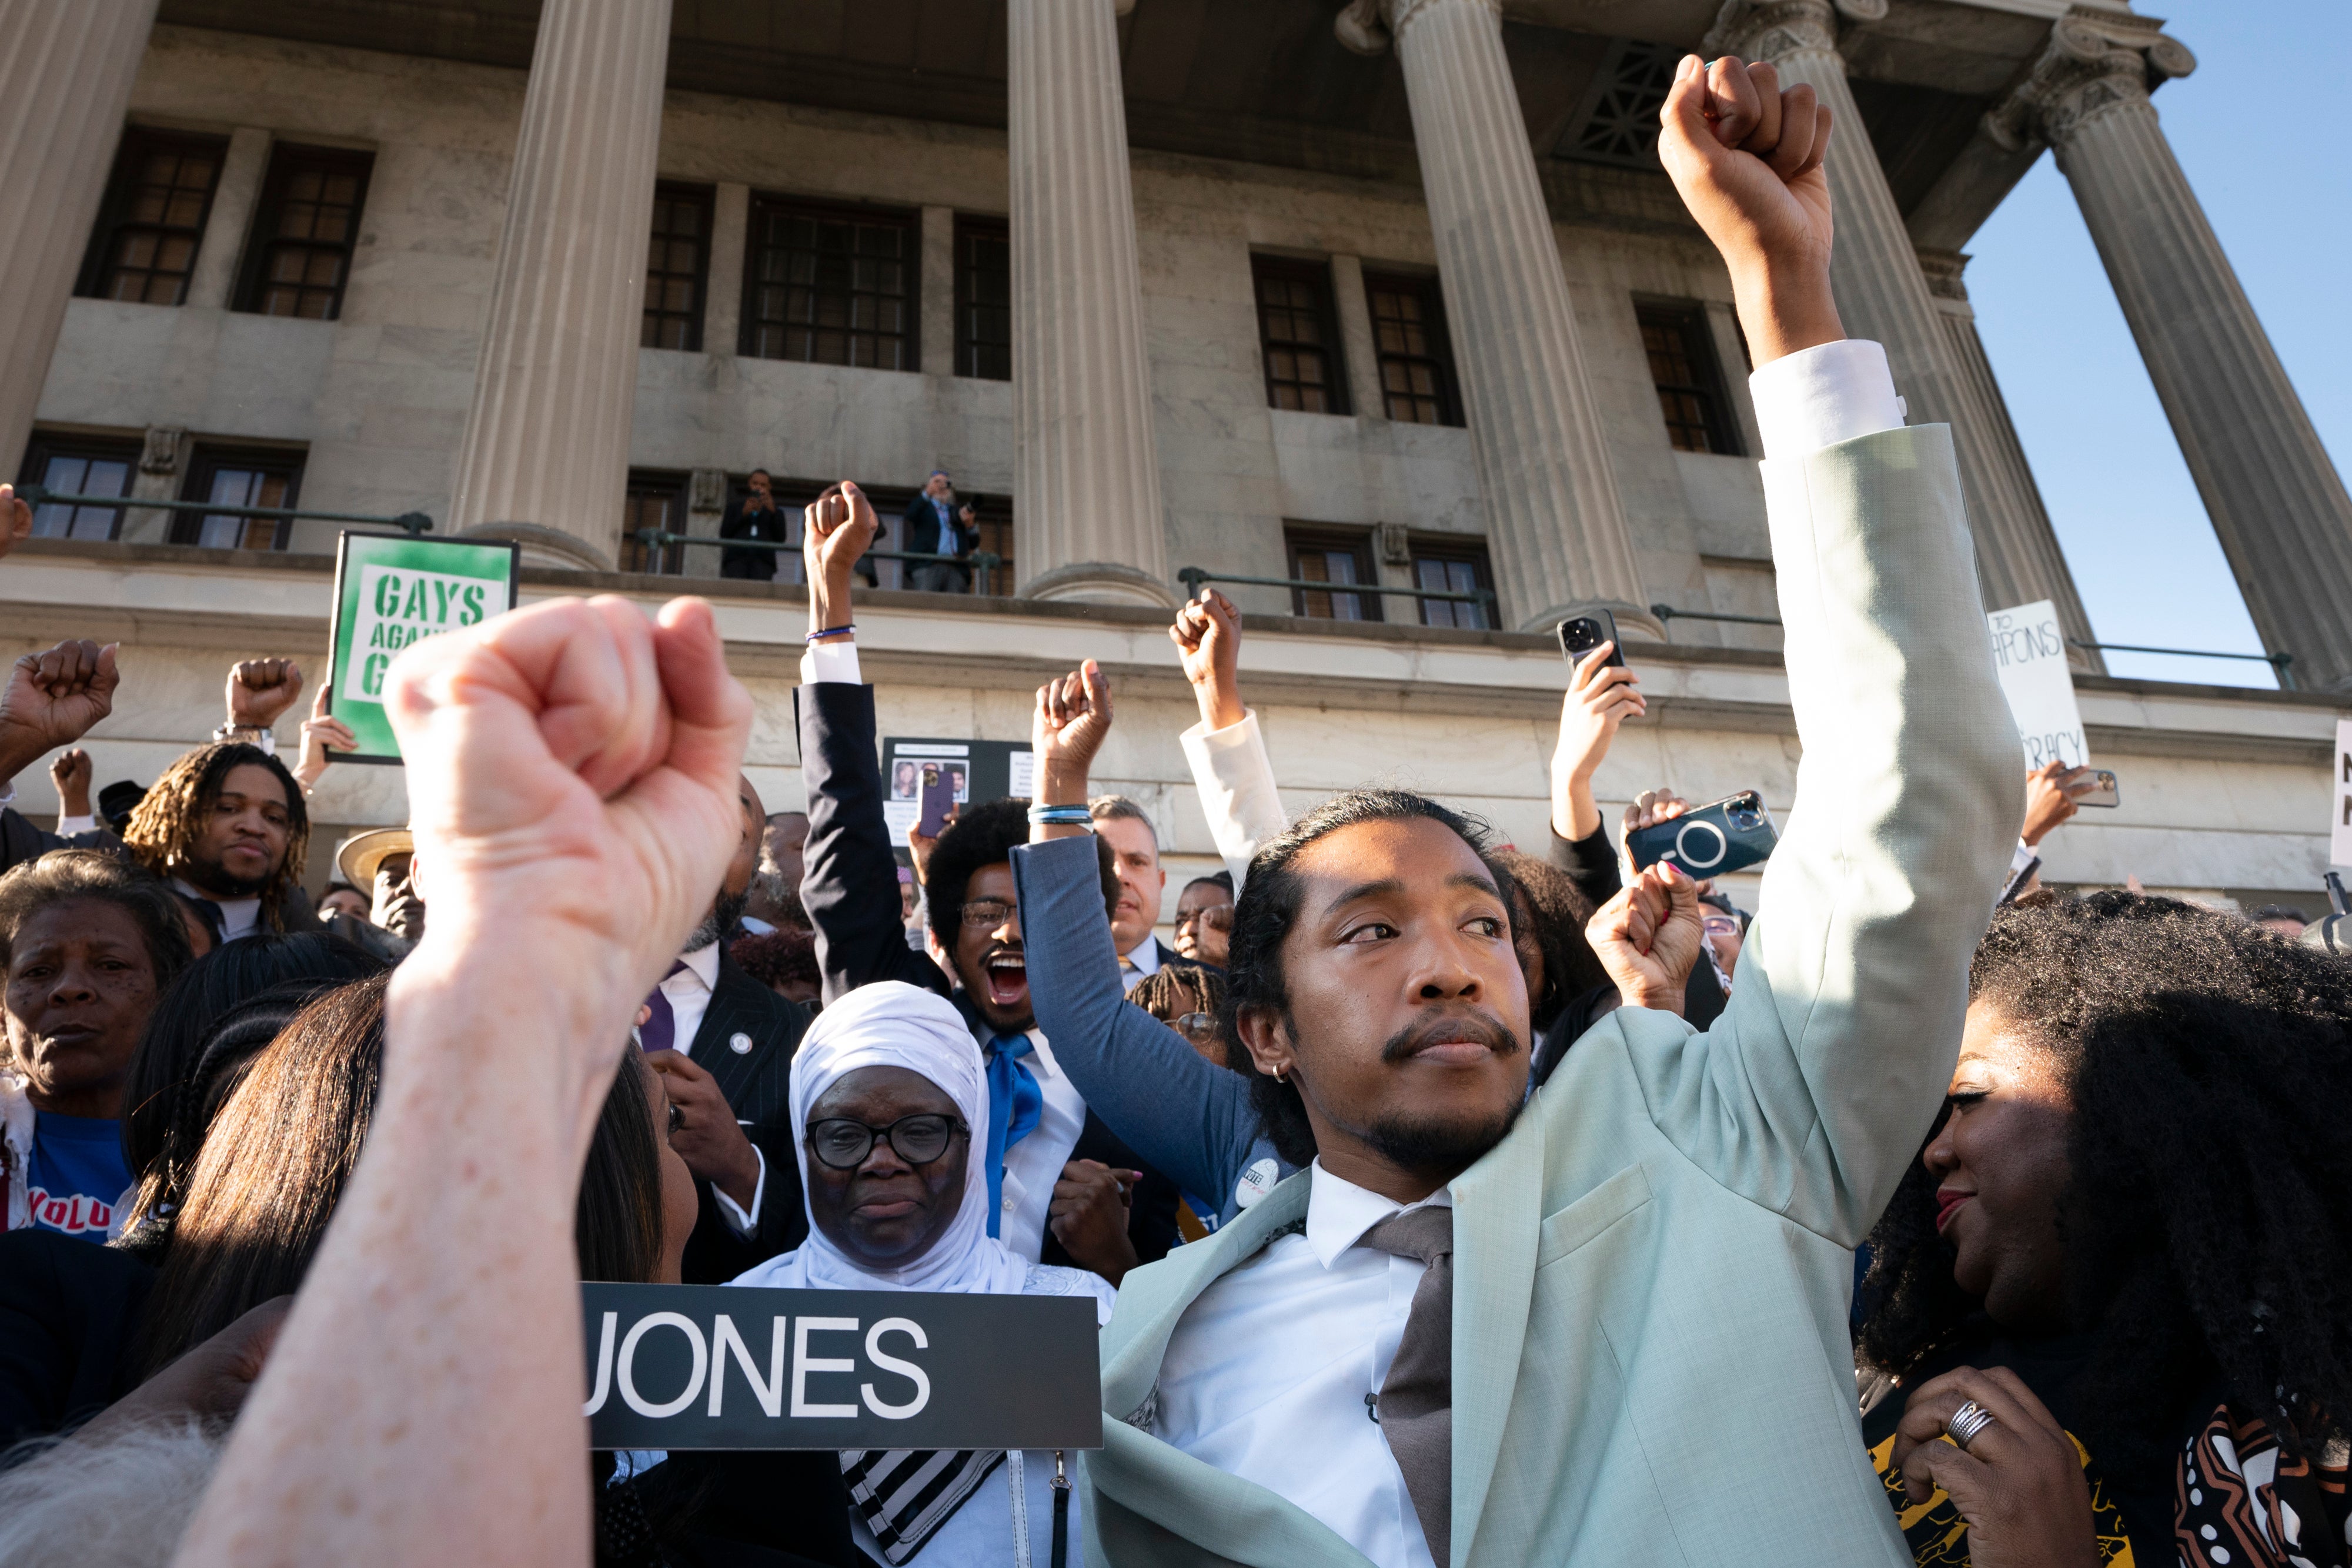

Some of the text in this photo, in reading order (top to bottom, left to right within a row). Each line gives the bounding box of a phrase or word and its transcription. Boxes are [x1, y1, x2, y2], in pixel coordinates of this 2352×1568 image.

[375, 574, 485, 626] GAYS
[370, 622, 447, 650] AGA
[1993, 614, 2012, 630] TO
[2022, 729, 2080, 770] RACY
[1244, 1169, 1263, 1185] VOTE
[21, 1191, 110, 1230] VOLU
[582, 1312, 931, 1419] JONES
